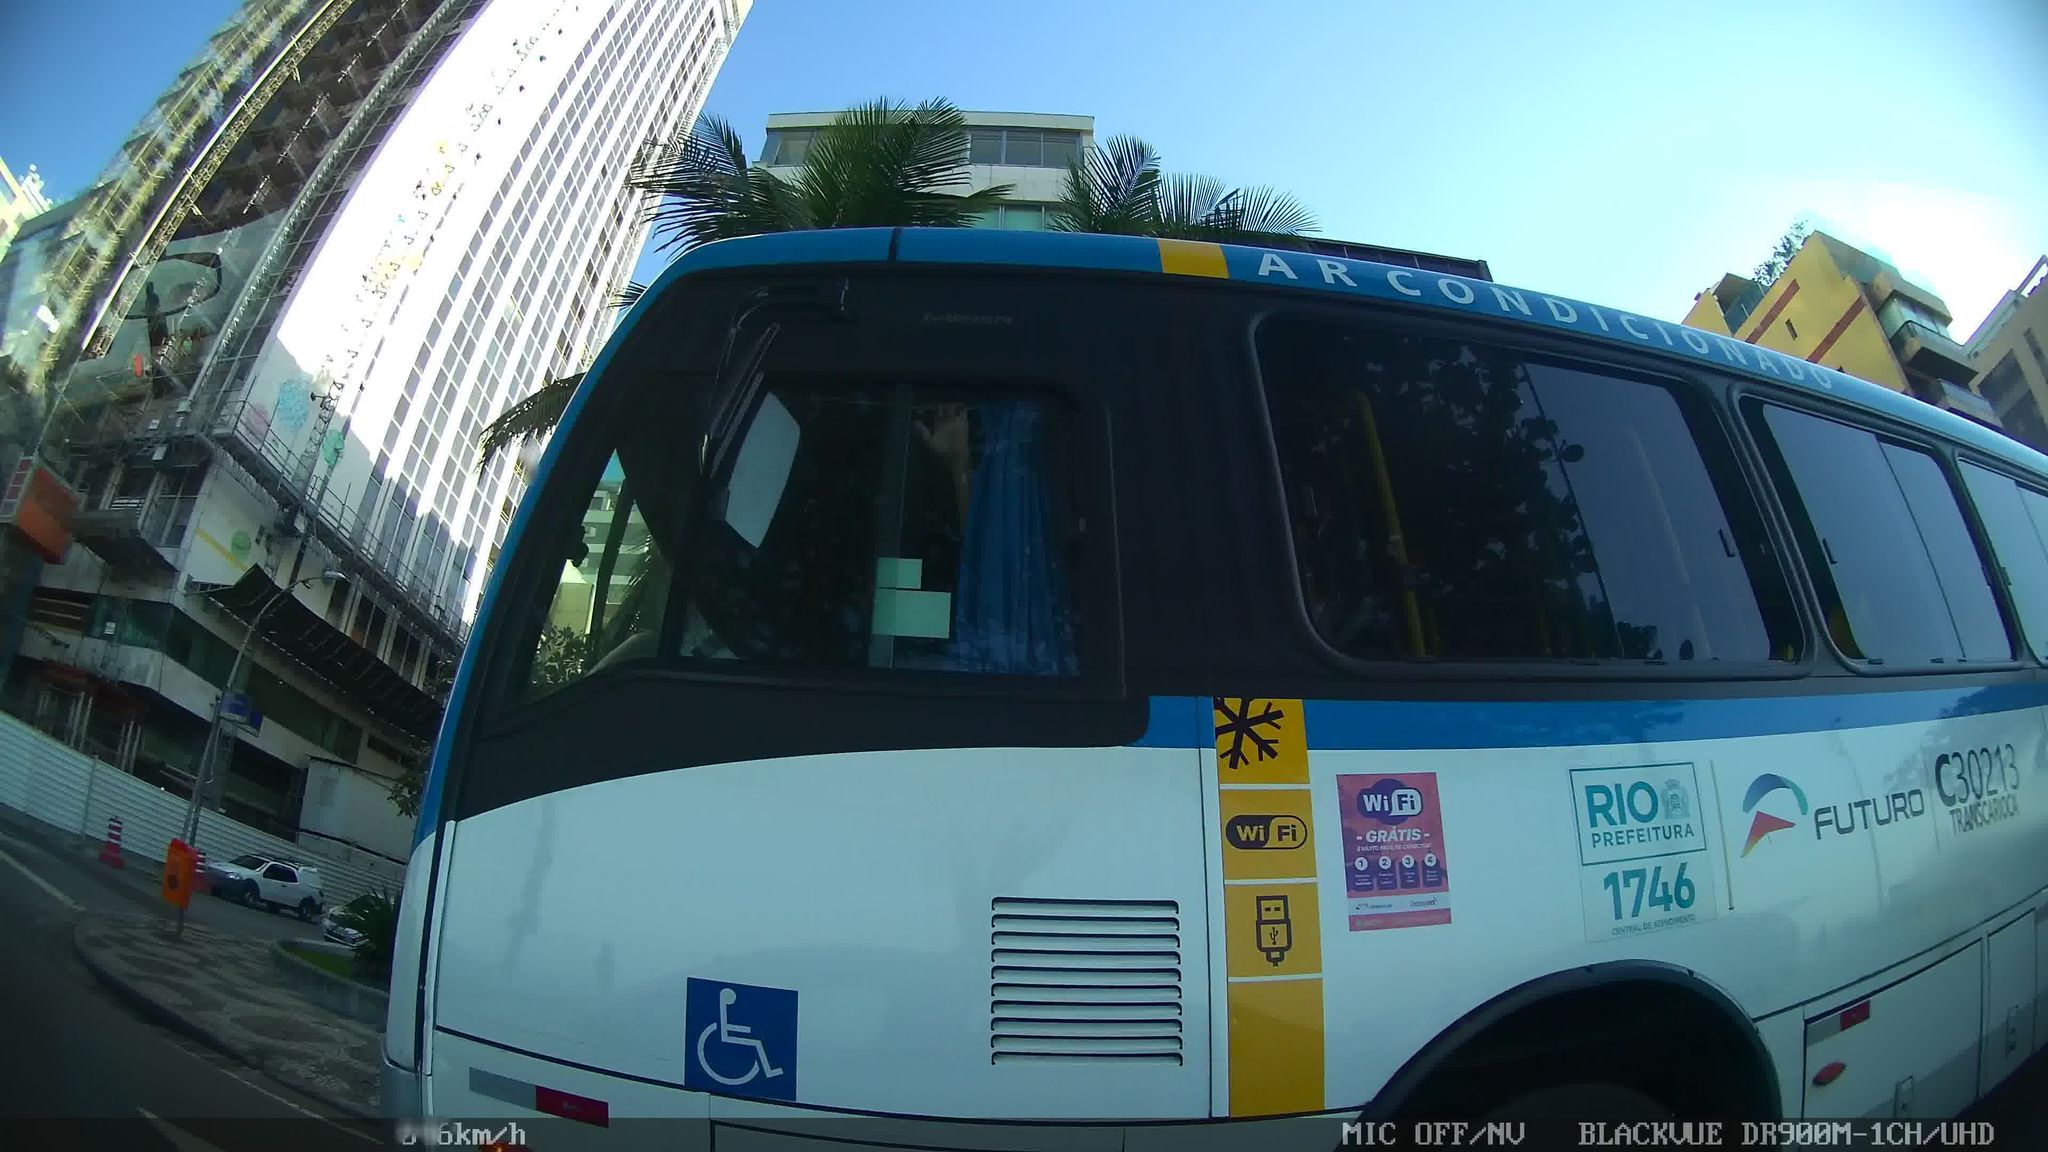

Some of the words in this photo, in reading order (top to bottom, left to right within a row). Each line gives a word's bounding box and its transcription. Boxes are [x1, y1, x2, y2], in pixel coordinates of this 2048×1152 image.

[1257, 252, 1358, 288] AR
[1386, 270, 1834, 390] CONDICIONADO
[1934, 743, 2020, 807] C30213
[1585, 781, 1659, 828] RIO
[1813, 788, 1925, 840] FUTURO
[1591, 823, 1695, 848] PREFEITURA
[1603, 862, 1696, 920] 1746
